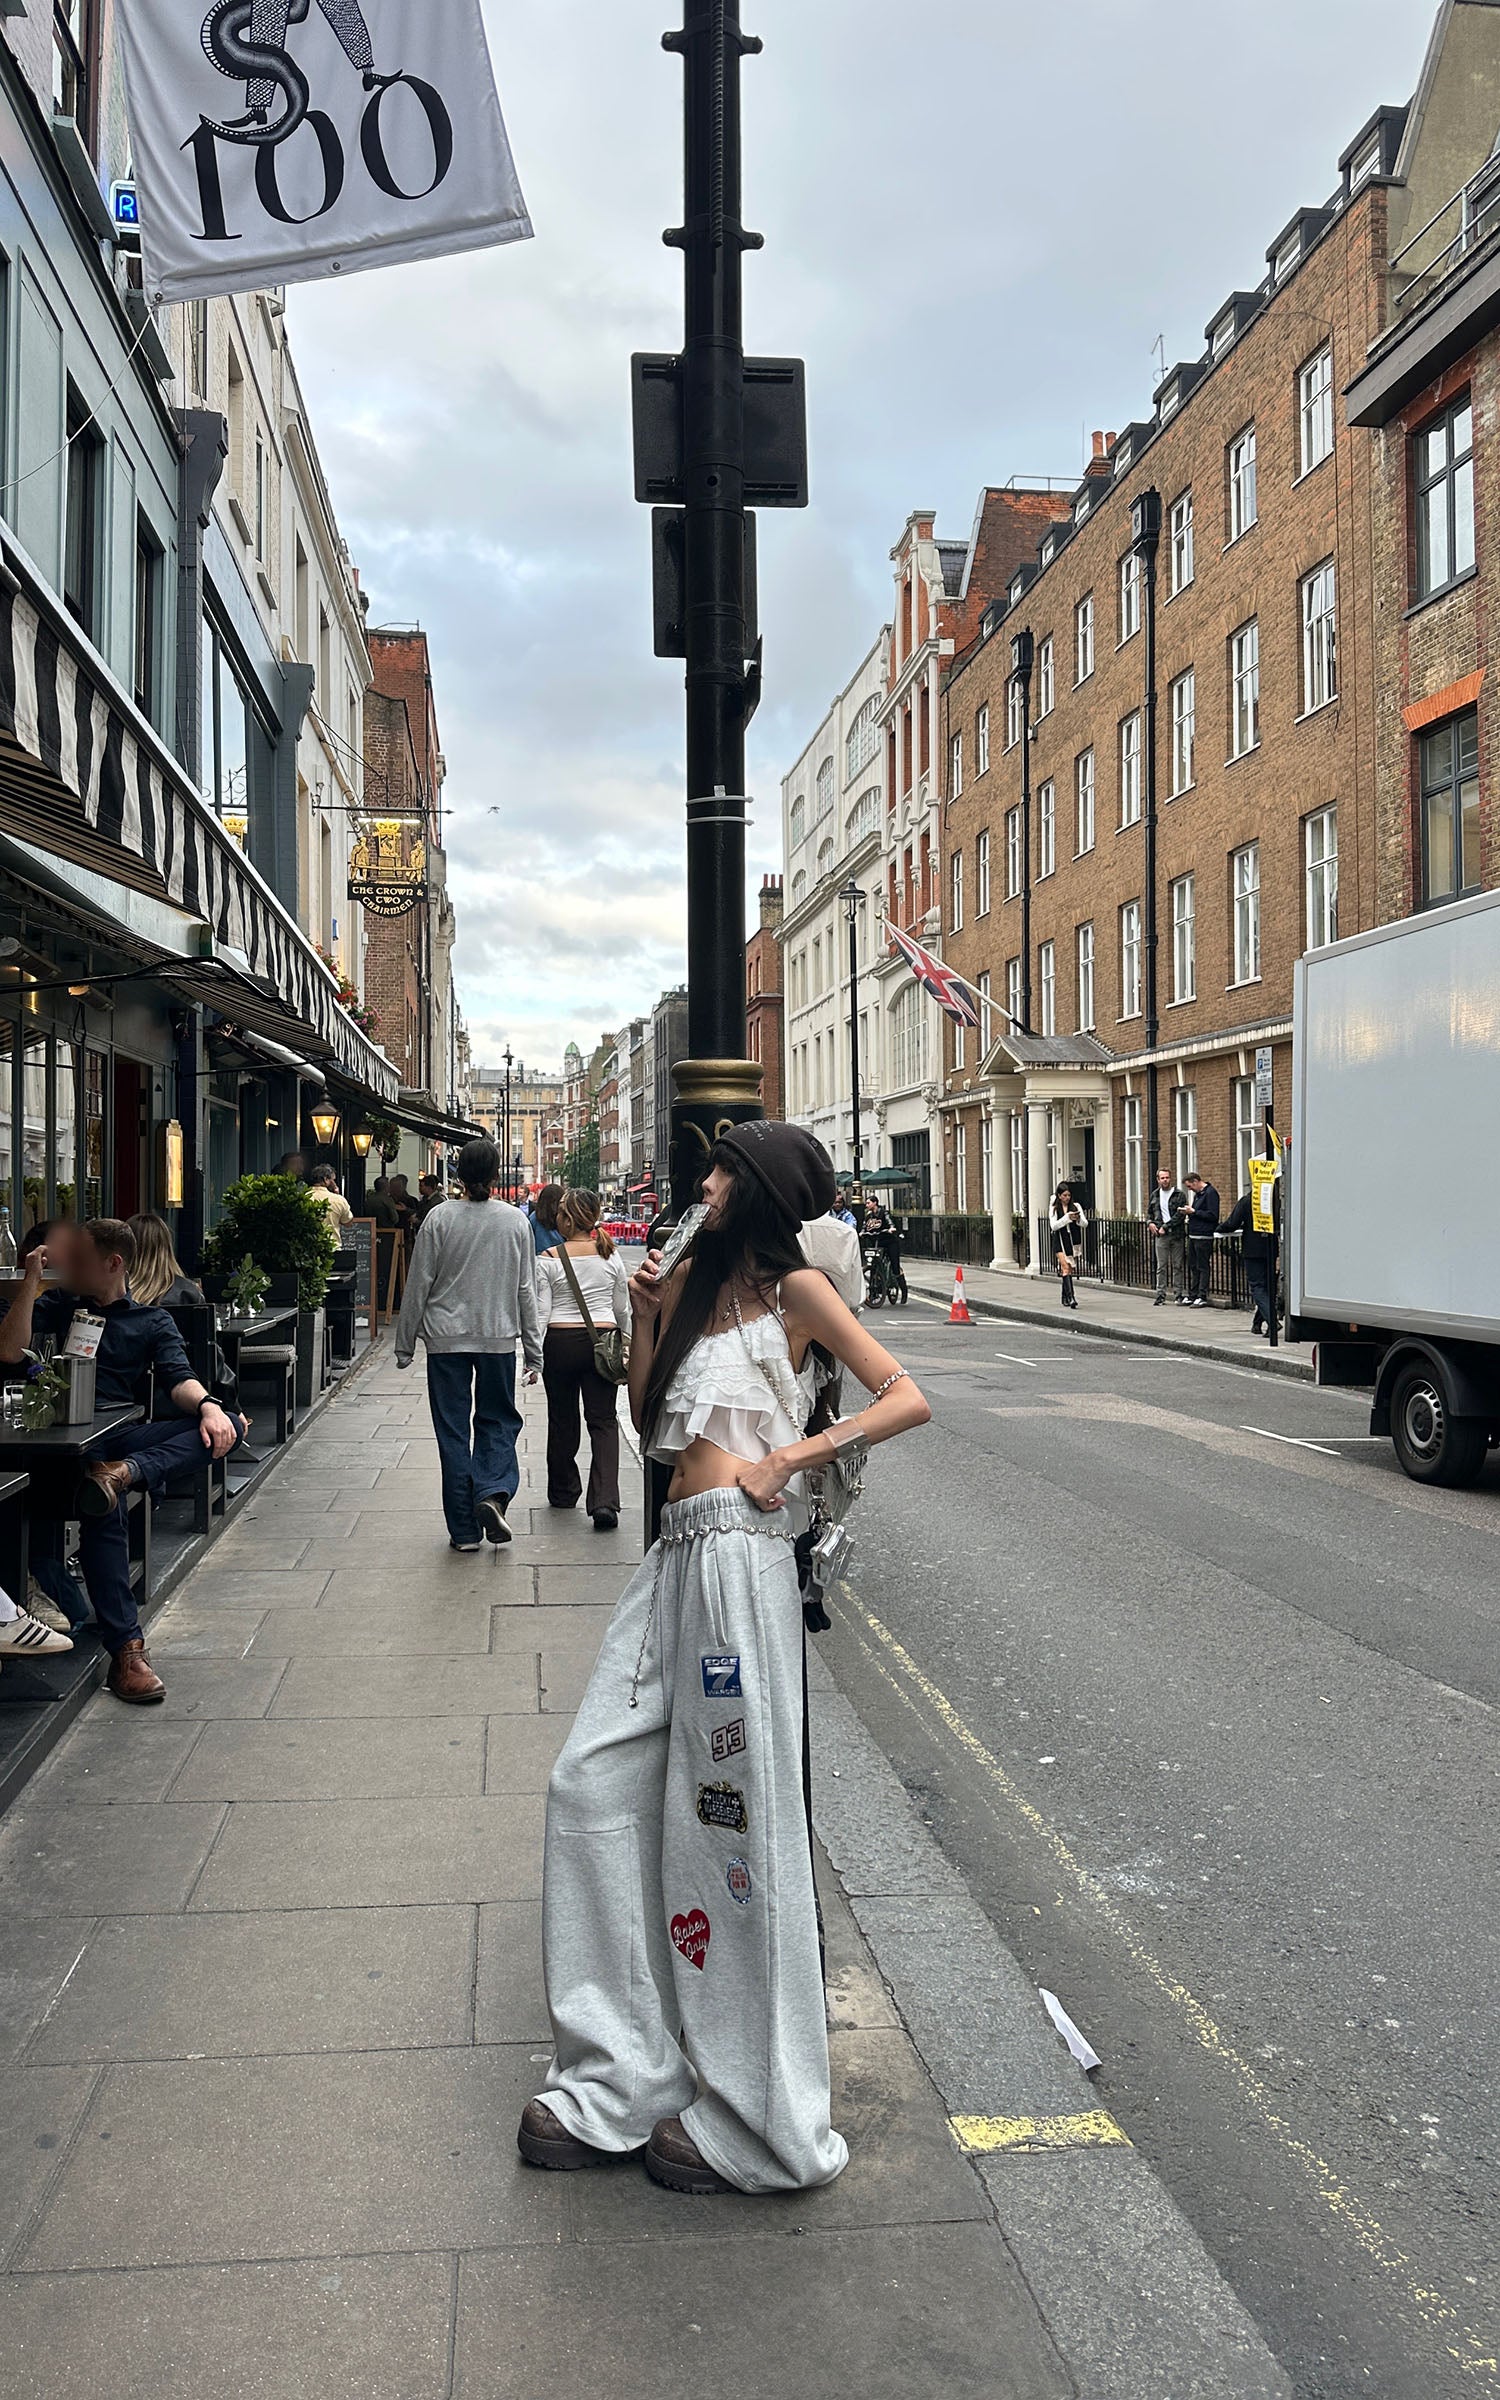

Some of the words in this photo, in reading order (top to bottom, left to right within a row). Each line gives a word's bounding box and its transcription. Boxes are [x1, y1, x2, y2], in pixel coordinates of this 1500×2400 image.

[180, 75, 453, 240] 100
[352, 886, 374, 894] THE
[376, 887, 414, 896] CROWN
[416, 888, 424, 897] &
[376, 896, 401, 904] TWO
[362, 896, 414, 915] CHAIRMEN
[706, 1666, 736, 1690] 7
[711, 1718, 746, 1762] 93
[674, 1919, 706, 1947] Babes
[686, 1938, 709, 1960] Only
